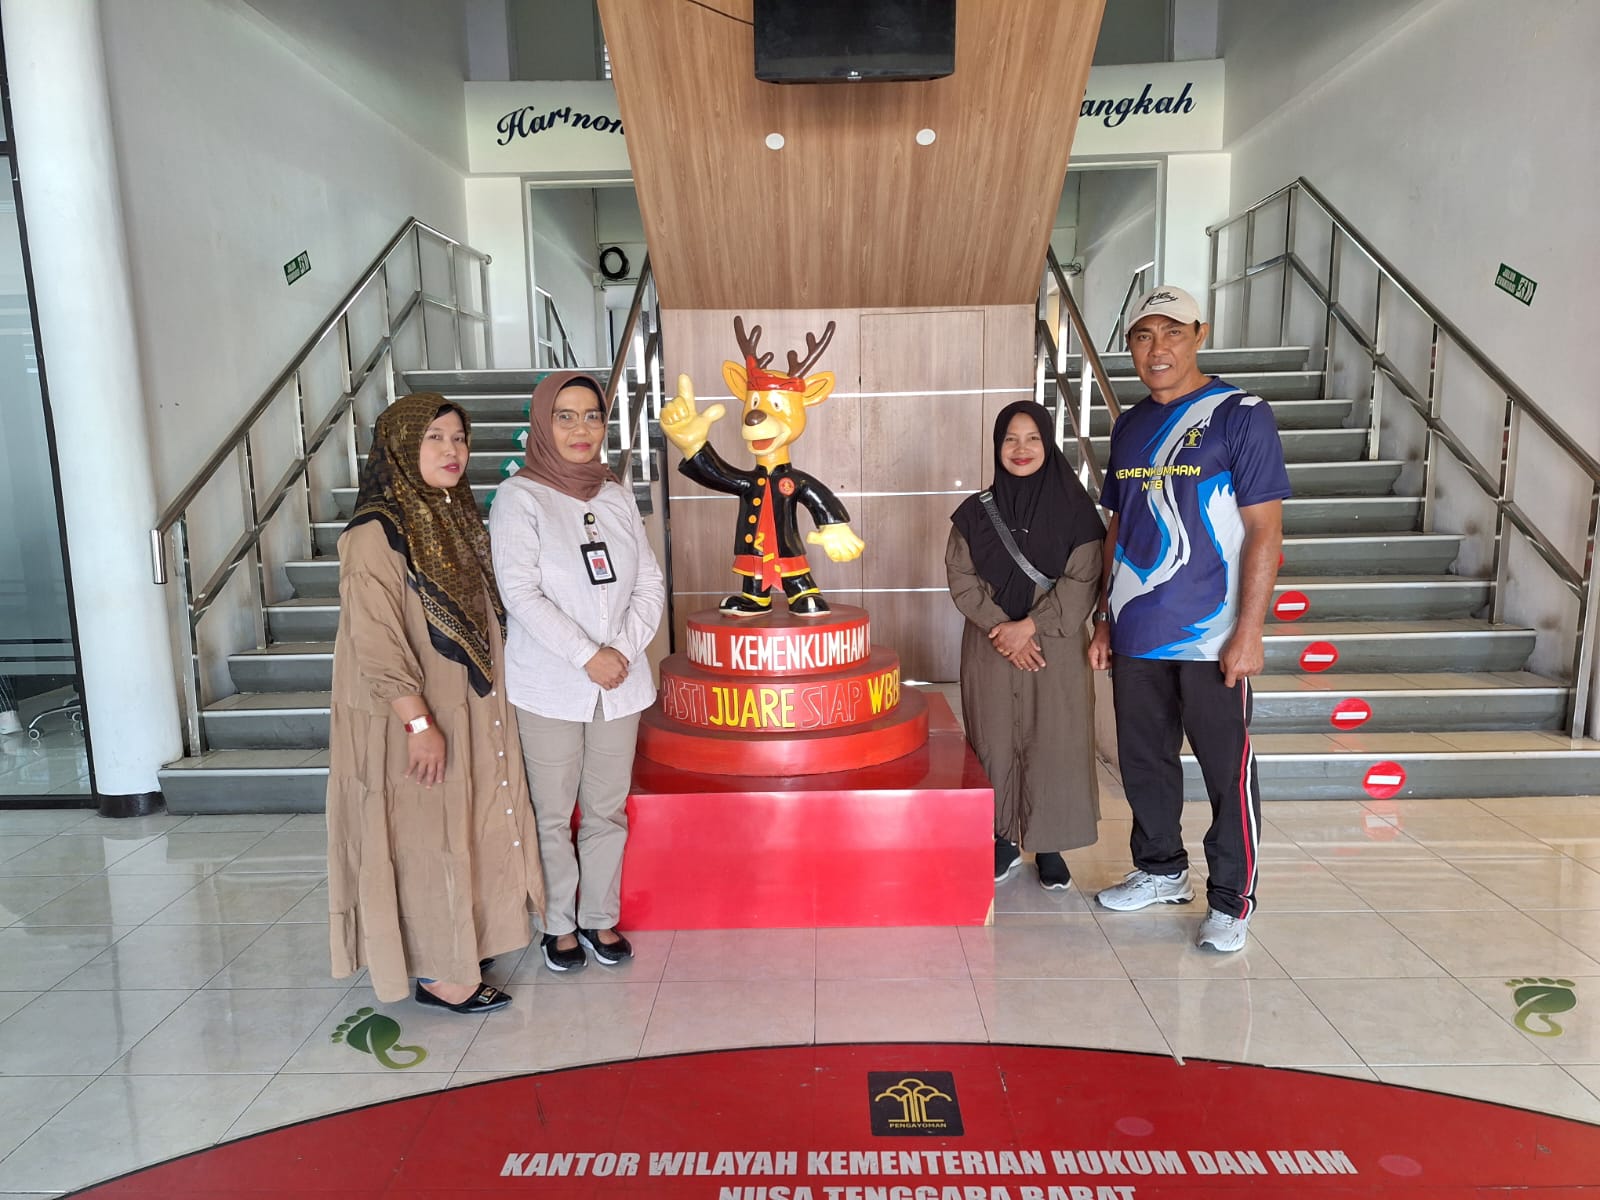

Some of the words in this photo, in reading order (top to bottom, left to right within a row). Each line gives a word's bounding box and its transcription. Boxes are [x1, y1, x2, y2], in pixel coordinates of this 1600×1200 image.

[1079, 82, 1197, 128] angkah
[730, 626, 865, 671] KEMENKUMHAM
[709, 686, 796, 729] JUARE
[801, 681, 863, 729] SIAP
[867, 667, 900, 715] WBB
[500, 1152, 641, 1177] KANTOR
[648, 1152, 798, 1176] WILAYAH
[807, 1151, 1047, 1176] KEMENTERIAN
[1051, 1150, 1188, 1175] HUKUM
[1187, 1150, 1269, 1175] DAN
[1266, 1150, 1360, 1175] HAM
